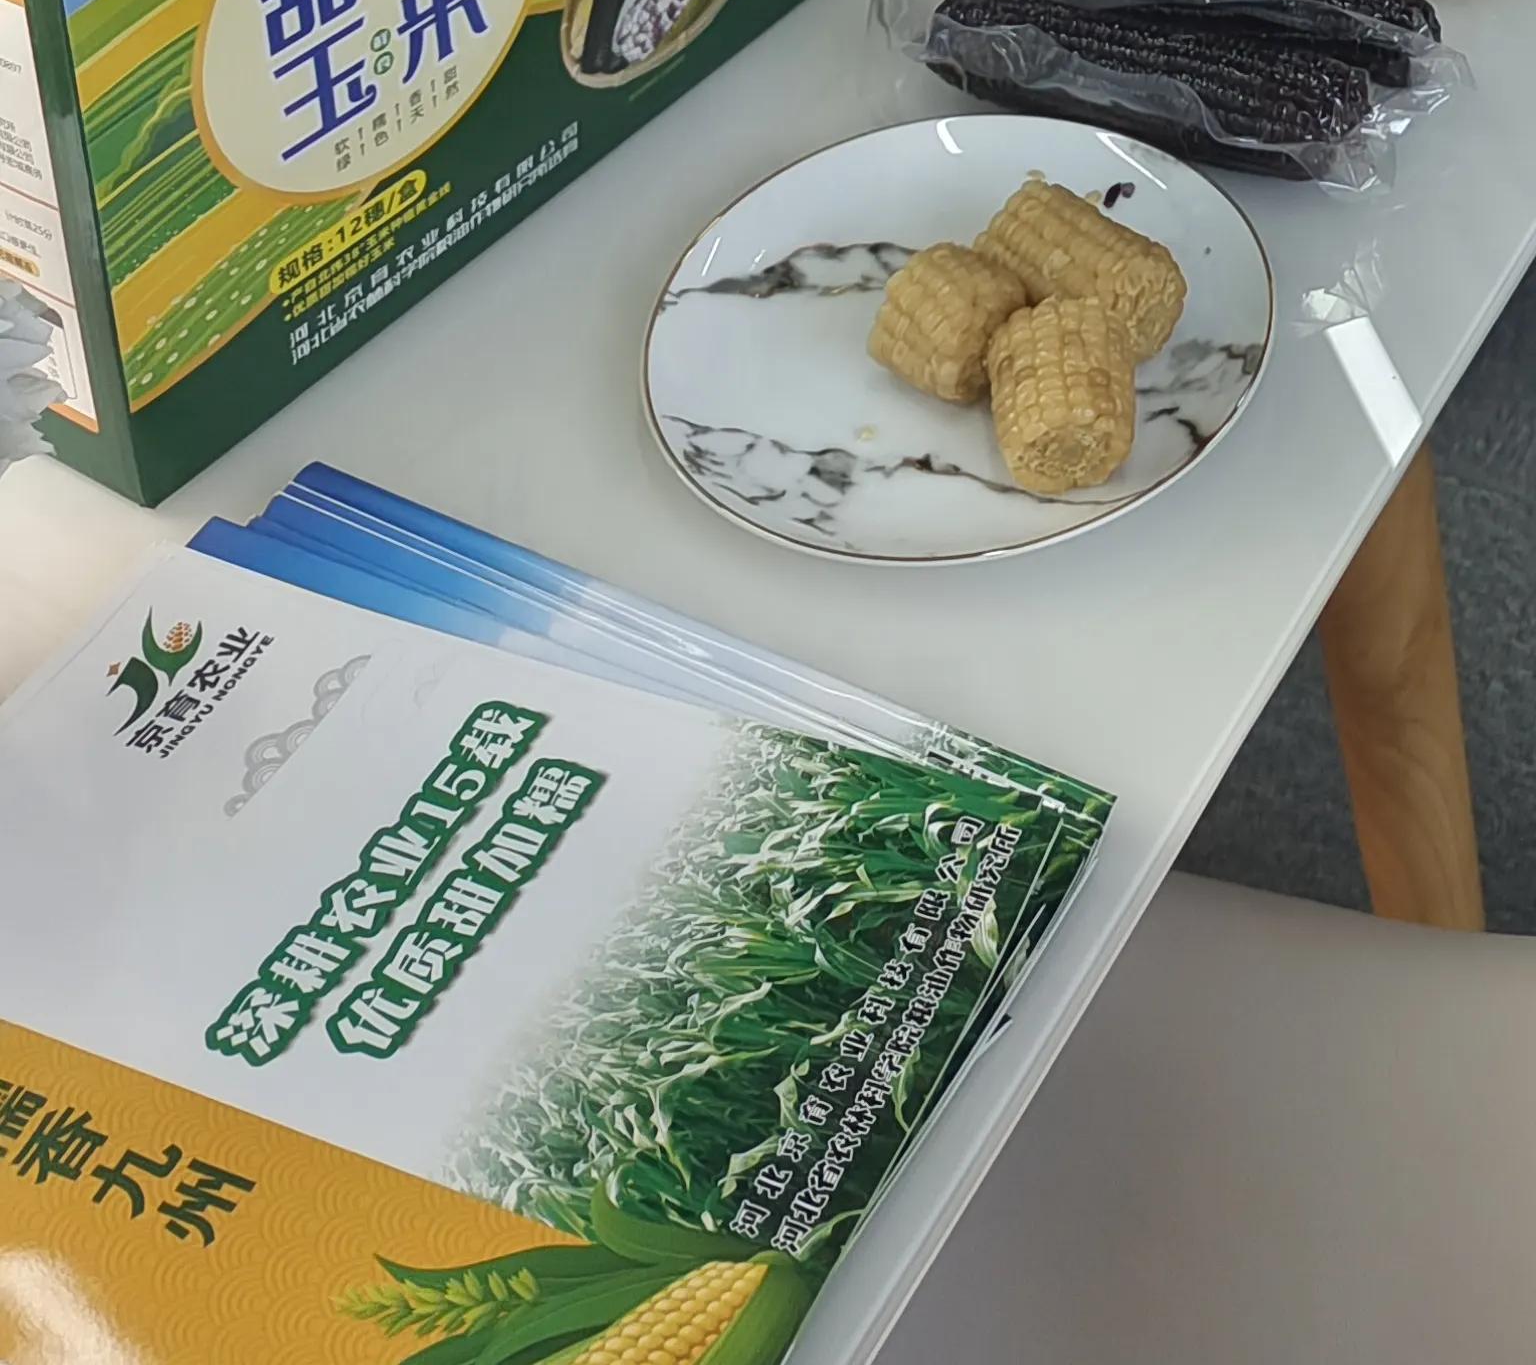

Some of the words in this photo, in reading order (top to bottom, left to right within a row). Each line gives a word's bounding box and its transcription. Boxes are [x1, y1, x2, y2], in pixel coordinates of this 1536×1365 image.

[289, 120, 578, 349] 河北京育农业科技有限公司
[125, 626, 261, 754] 京育农业
[159, 703, 214, 759] JINGYU
[213, 635, 275, 701] NONGYE
[214, 706, 538, 1060] 深耕农业15载
[335, 763, 594, 1052] 优质甜加糯
[730, 816, 984, 1239] 河北京育农业科技有限公司
[771, 822, 1022, 1256] 河北省农林科学院粮油作物研究所
